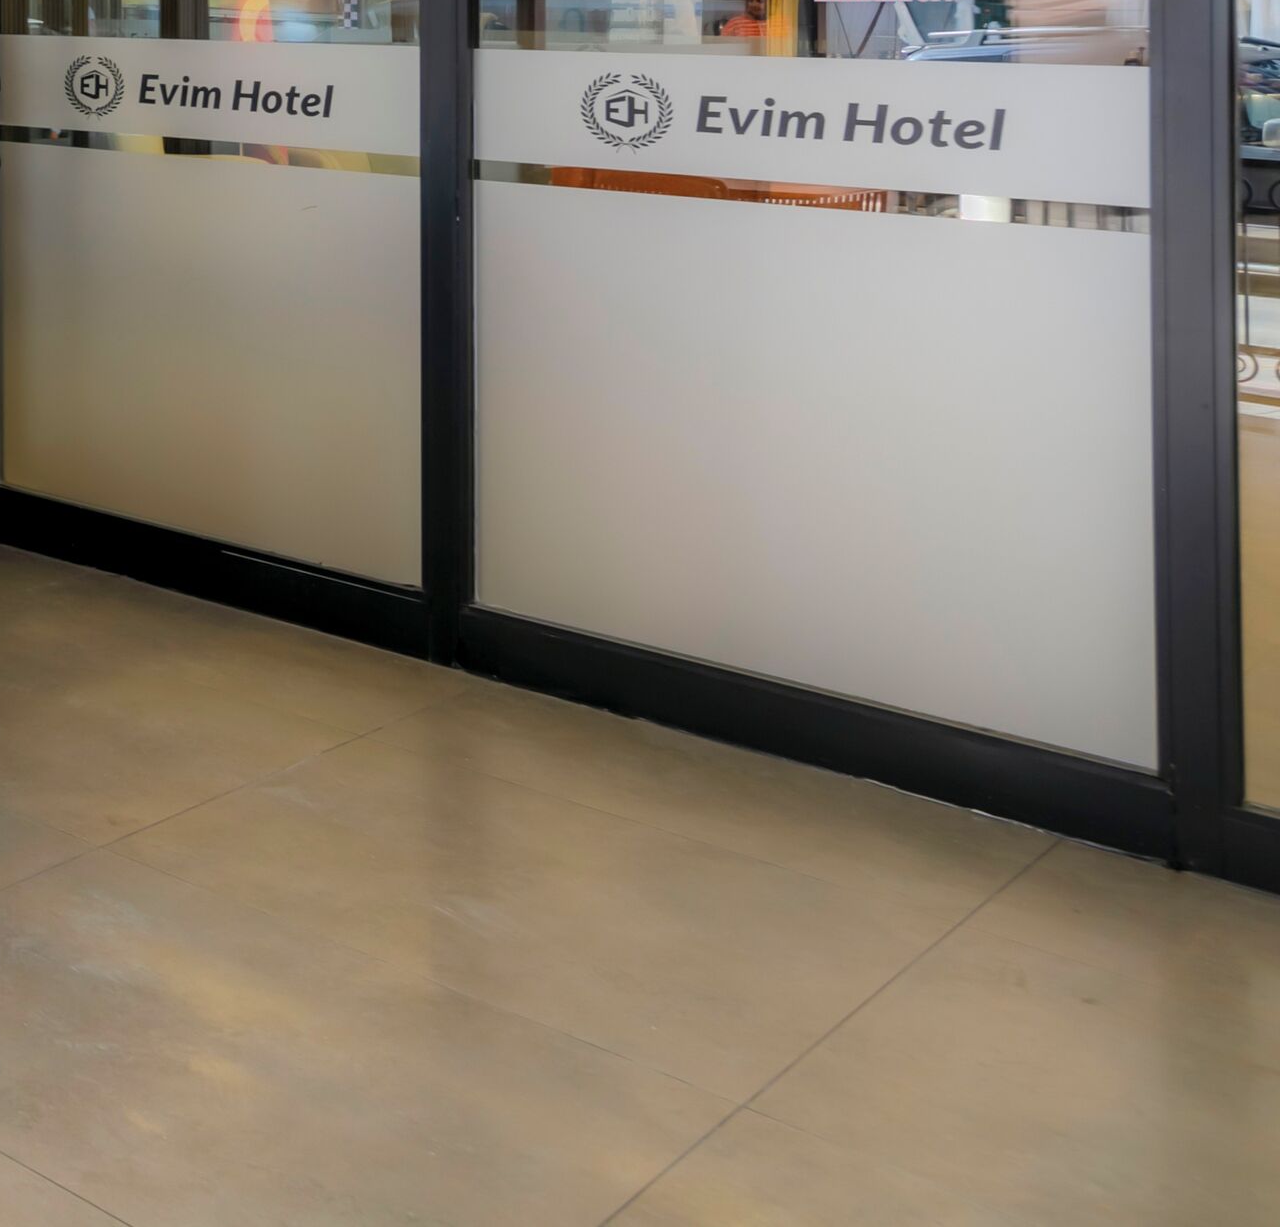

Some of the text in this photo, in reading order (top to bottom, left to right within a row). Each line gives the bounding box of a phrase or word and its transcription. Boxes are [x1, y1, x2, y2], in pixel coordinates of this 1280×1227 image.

[138, 73, 334, 118] Evim Hotel
[695, 95, 1006, 151] Evim Hotel
